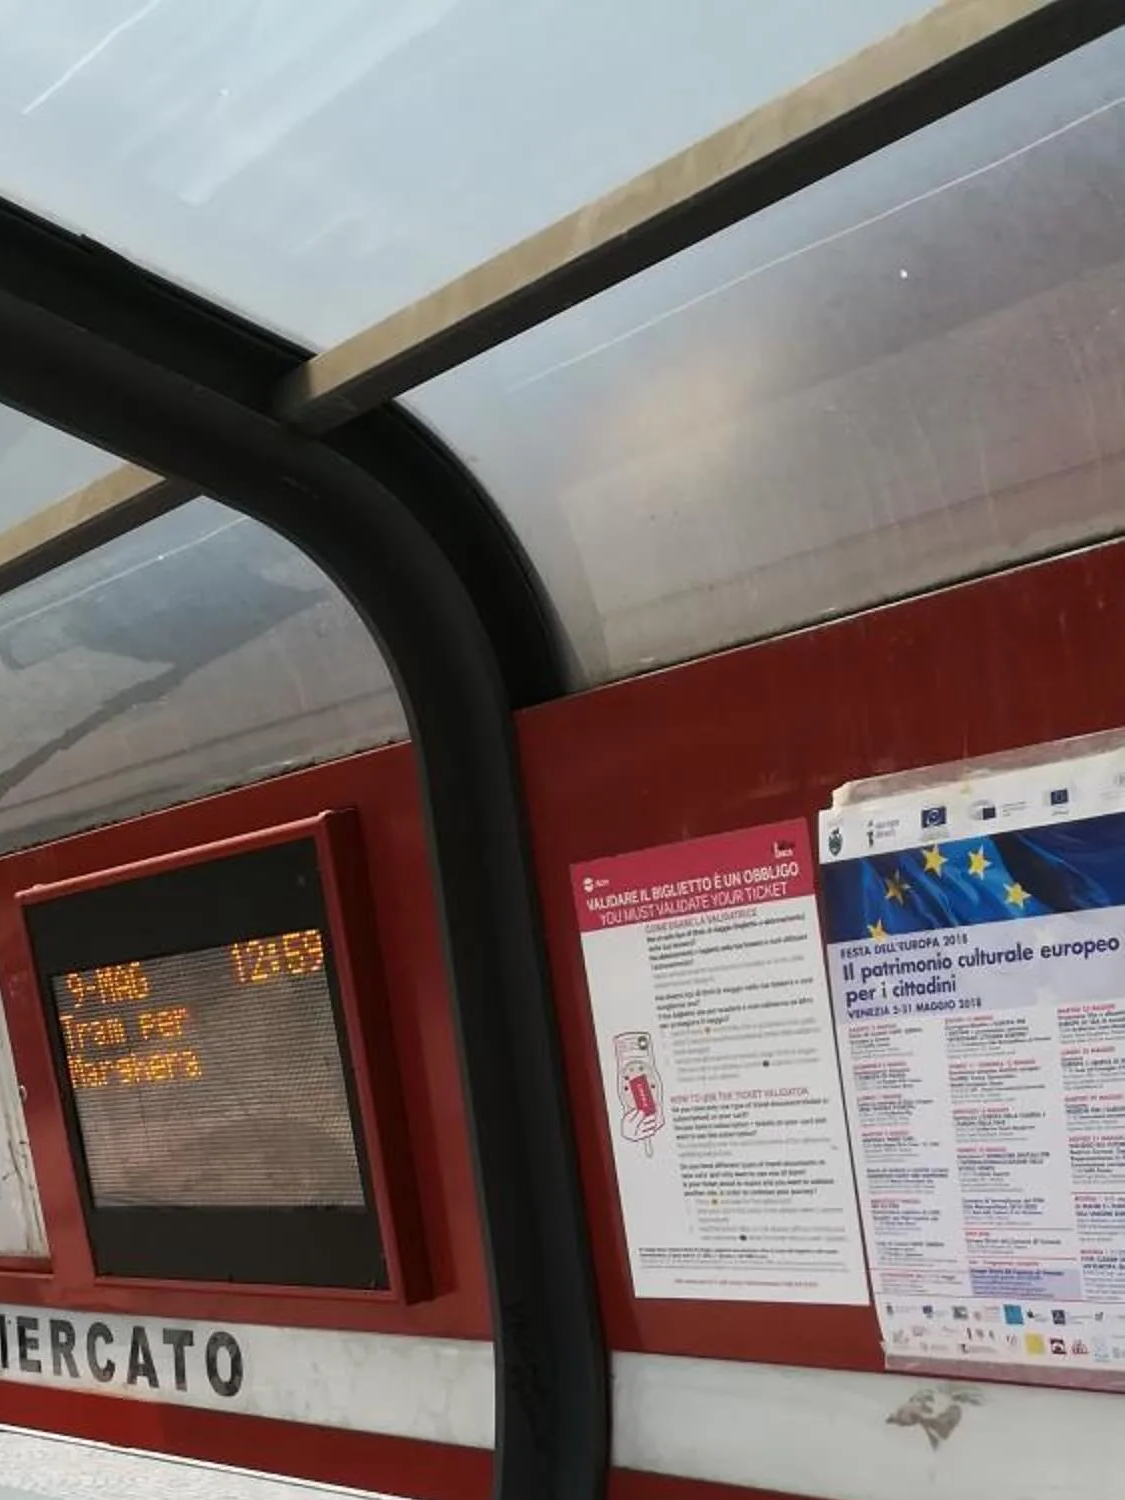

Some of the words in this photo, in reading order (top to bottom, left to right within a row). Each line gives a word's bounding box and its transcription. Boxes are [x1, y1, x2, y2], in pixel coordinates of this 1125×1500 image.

[586, 889, 639, 911] VALIDARE
[640, 889, 651, 902] IL
[651, 877, 712, 901] BIGLIETTO
[723, 872, 741, 887] UN
[743, 861, 799, 883] OBBLIGO
[602, 908, 622, 926] YOU
[623, 904, 655, 921] MUST
[655, 894, 709, 915] VALIDATE
[711, 889, 744, 907] YOUR
[744, 881, 787, 902] TICKET
[230, 928, 324, 984] 12:59
[943, 933, 968, 947] 2018
[860, 952, 952, 984] patrimonio
[958, 942, 1034, 967] culturale
[1040, 937, 1120, 960] europeo
[846, 988, 876, 1008] per
[881, 981, 887, 998] i
[892, 973, 956, 997] cittadini
[847, 1005, 890, 1019] VENEZIA
[916, 999, 956, 1012] MAGGIO
[958, 997, 982, 1009] 2018
[59, 1014, 125, 1049] Tram
